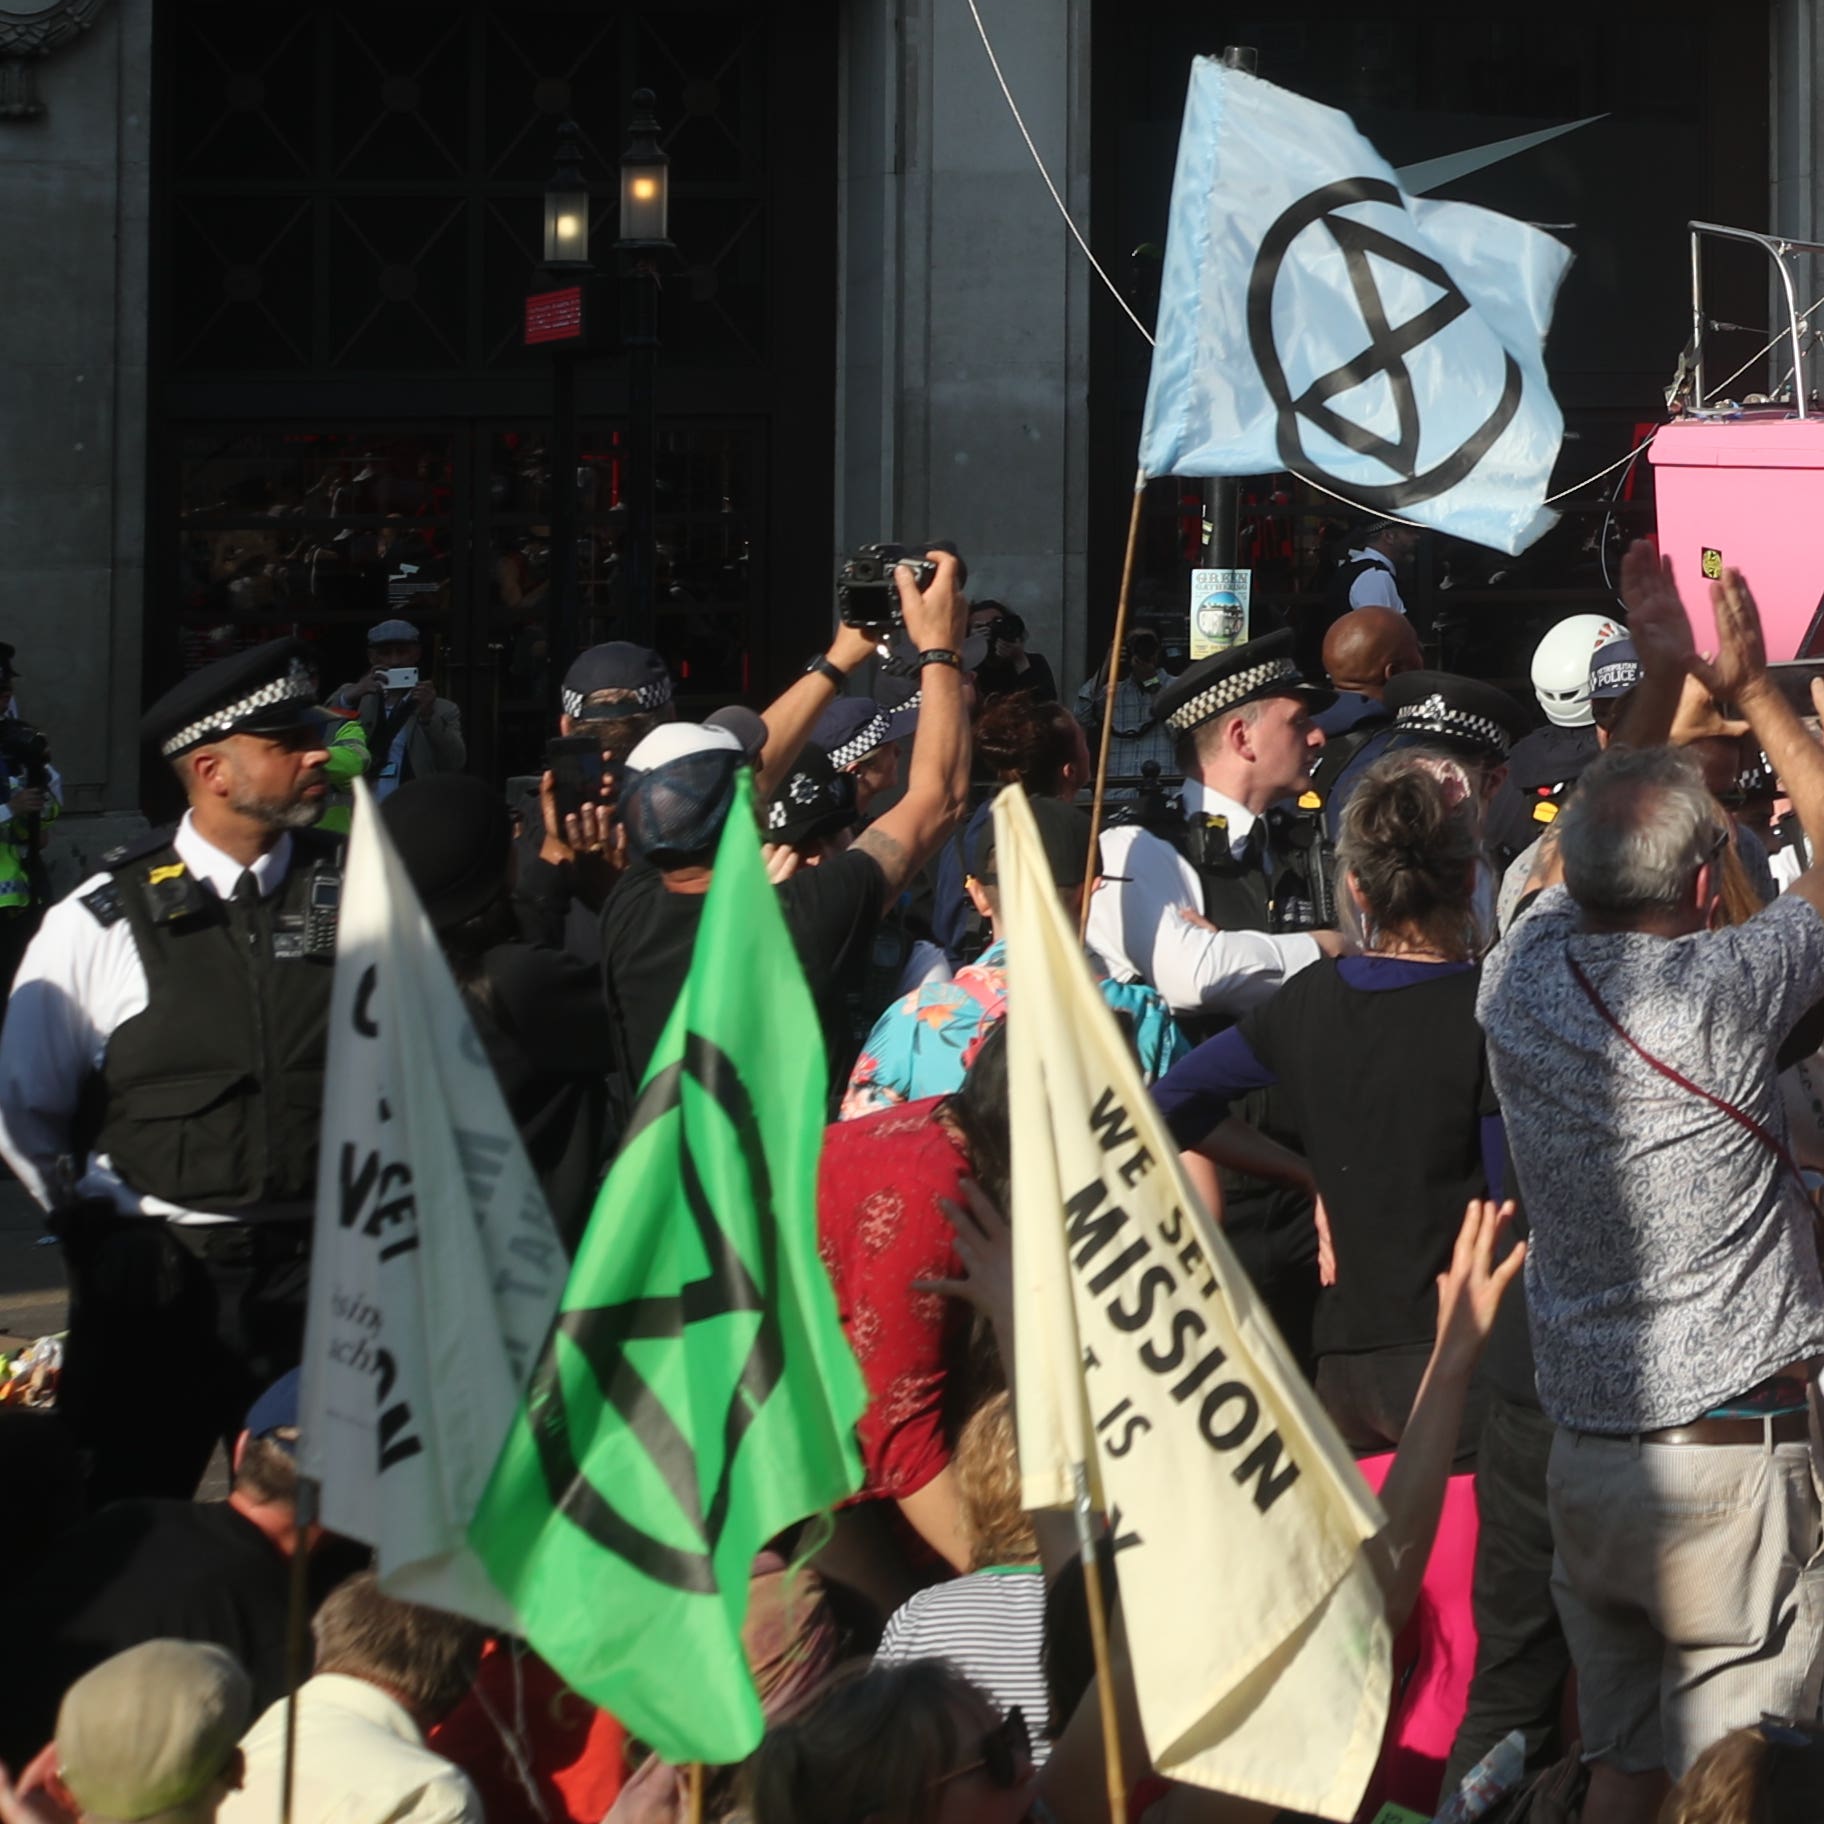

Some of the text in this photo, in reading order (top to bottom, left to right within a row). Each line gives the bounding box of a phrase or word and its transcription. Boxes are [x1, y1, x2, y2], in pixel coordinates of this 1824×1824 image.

[1598, 669, 1636, 688] POLICE
[1089, 1087, 1157, 1190] WE
[1065, 1177, 1301, 1516] MISSION
[1096, 1397, 1152, 1458] IS
